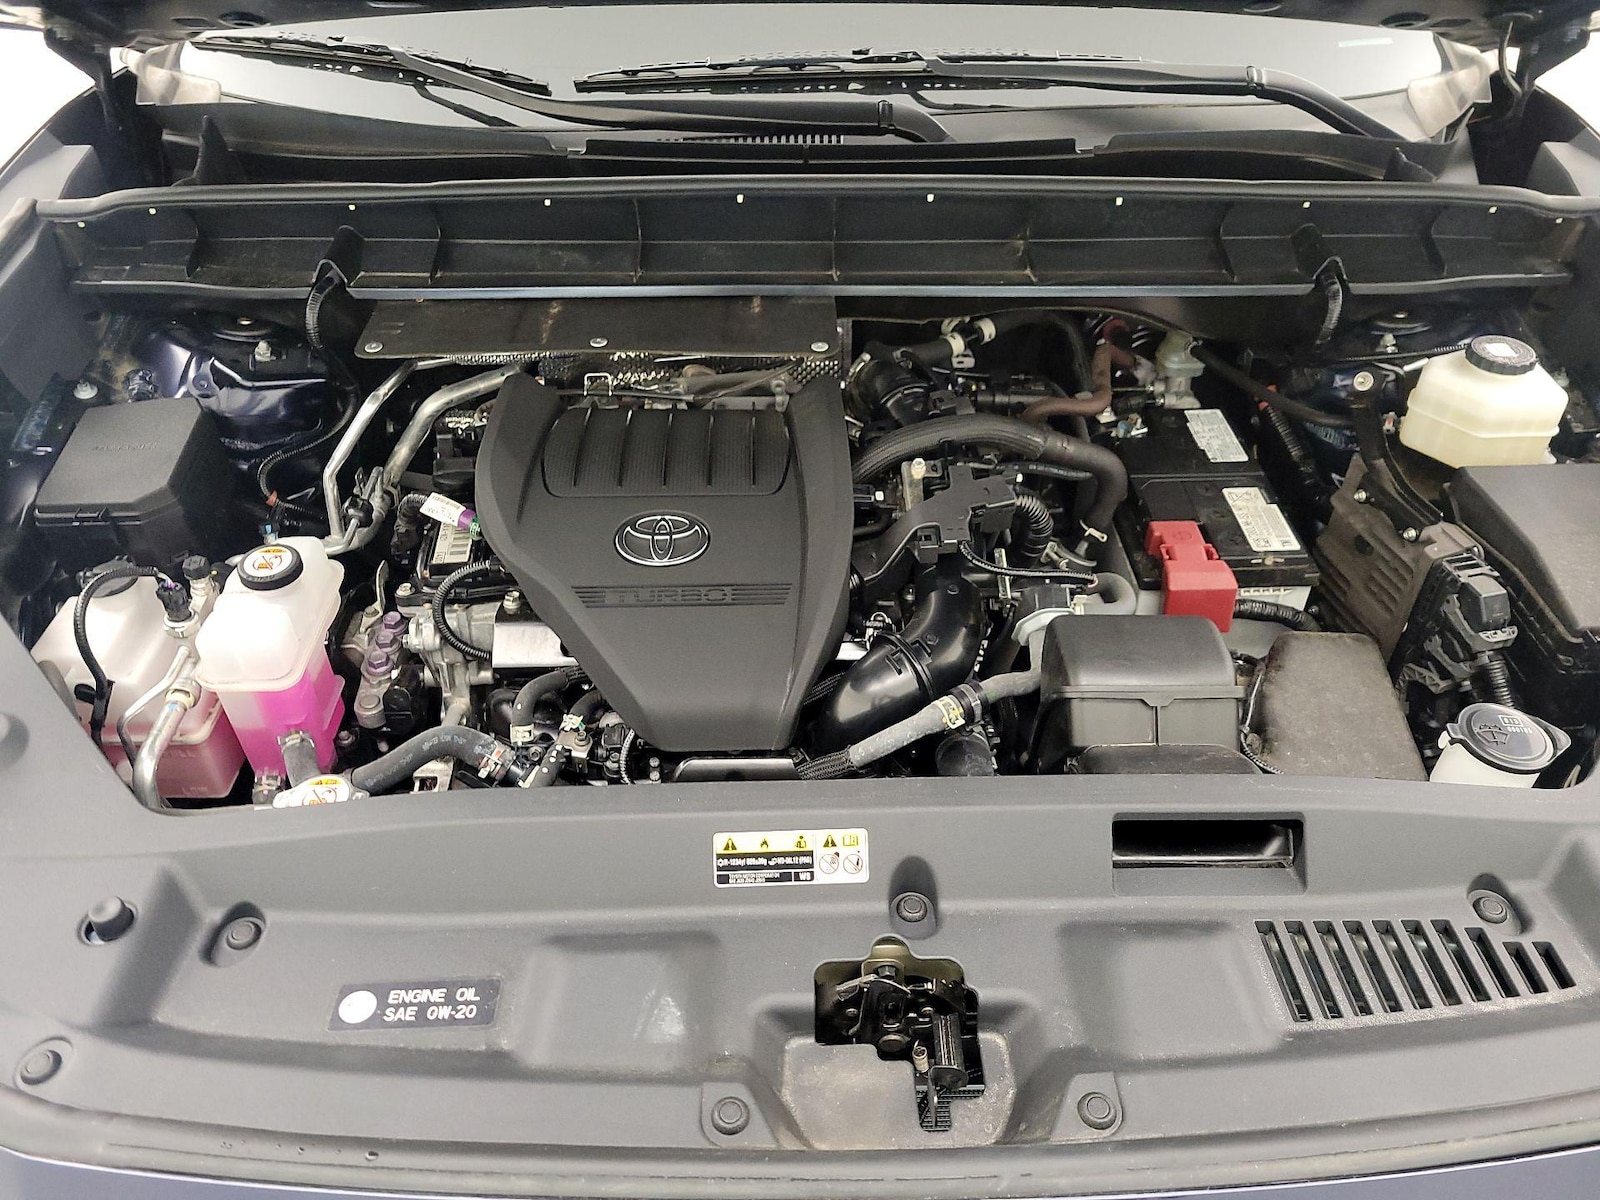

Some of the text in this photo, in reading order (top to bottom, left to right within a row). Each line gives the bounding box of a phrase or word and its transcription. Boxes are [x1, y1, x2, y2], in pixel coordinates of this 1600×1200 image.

[606, 588, 728, 603] TURBO
[388, 987, 481, 1004] ENGINE OIL
[383, 1005, 477, 1022] SAE 0W-20
